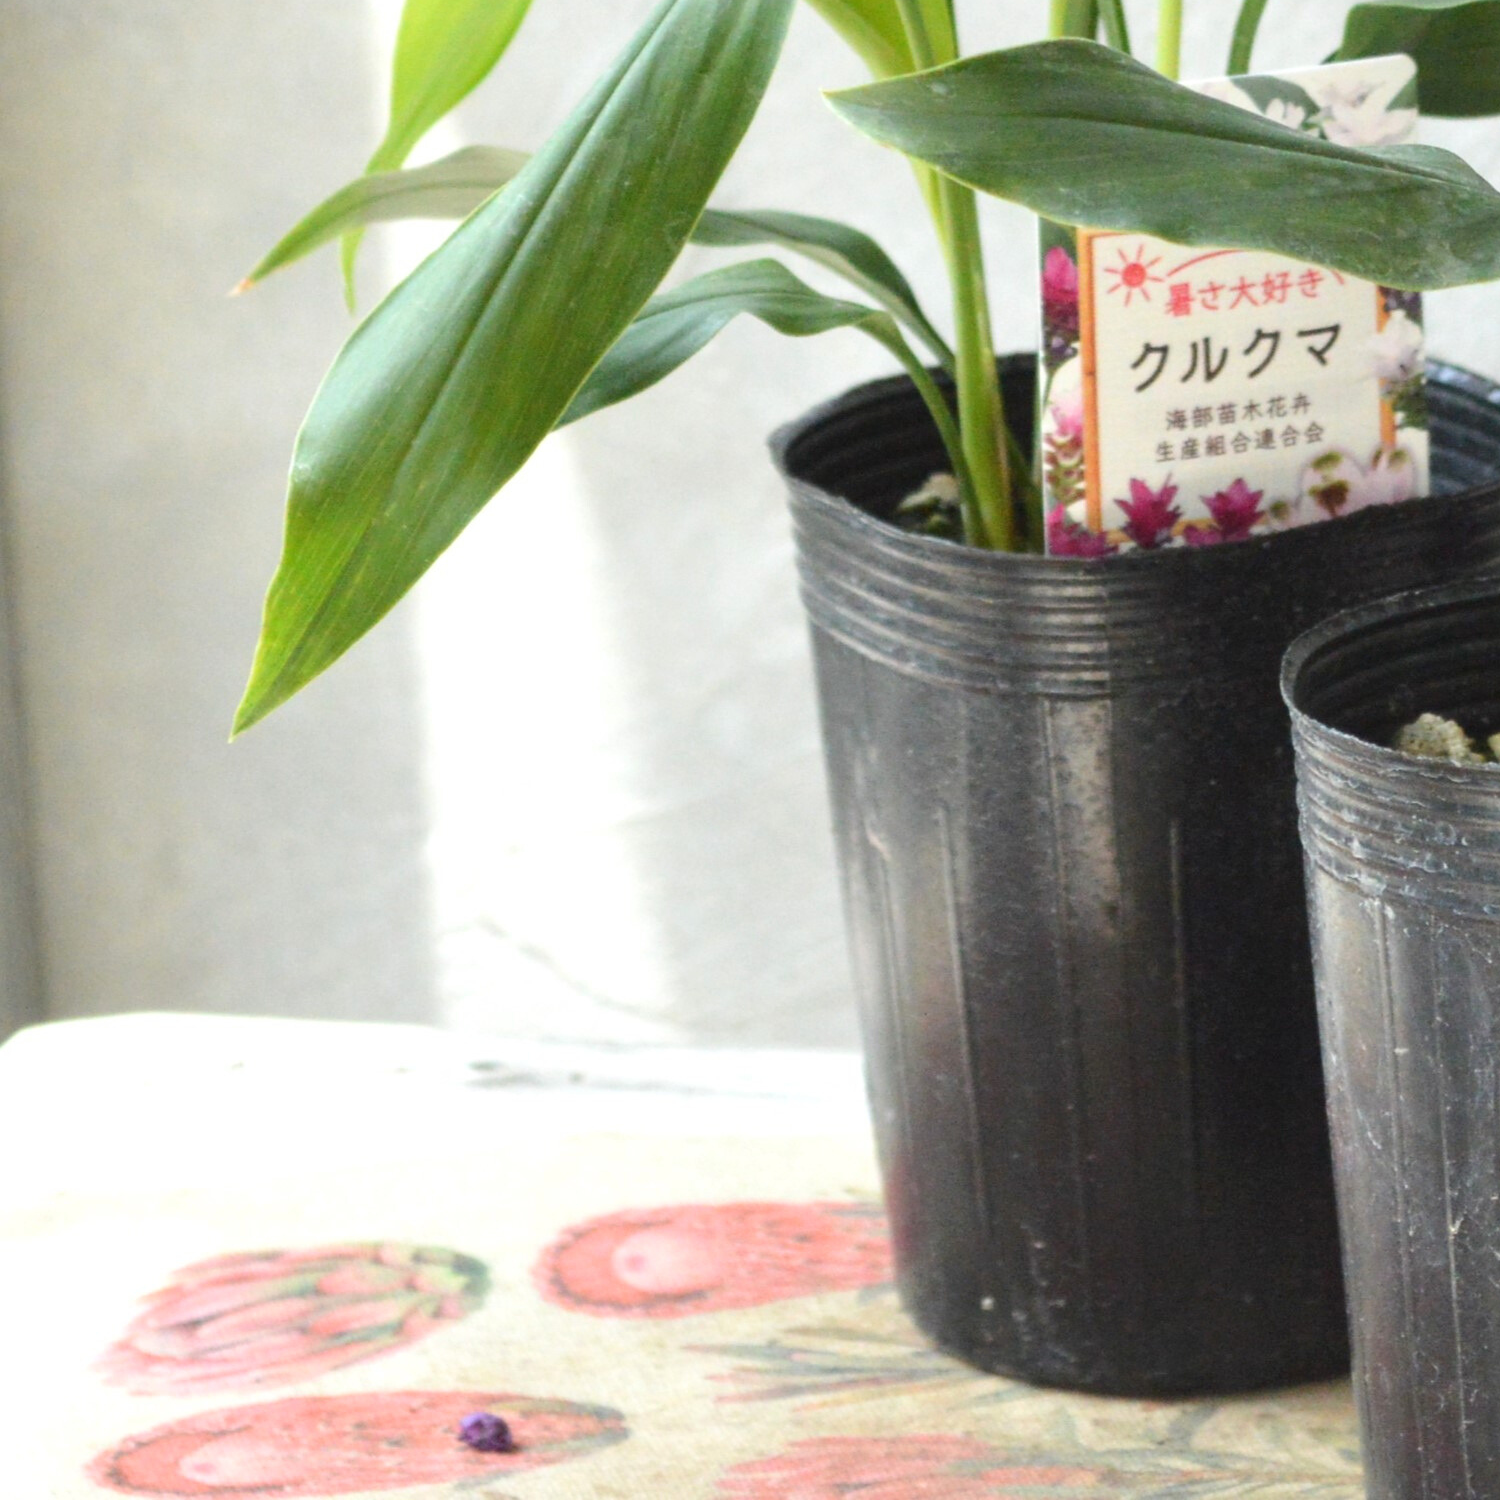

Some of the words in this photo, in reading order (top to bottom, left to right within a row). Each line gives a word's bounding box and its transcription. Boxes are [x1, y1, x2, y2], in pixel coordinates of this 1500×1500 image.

[1164, 269, 1325, 317] 暑さ大好き
[1130, 323, 1342, 392] クルクマ
[1165, 394, 1312, 430] 海部苗木花卉
[1155, 421, 1325, 463] 生産組合連合会
